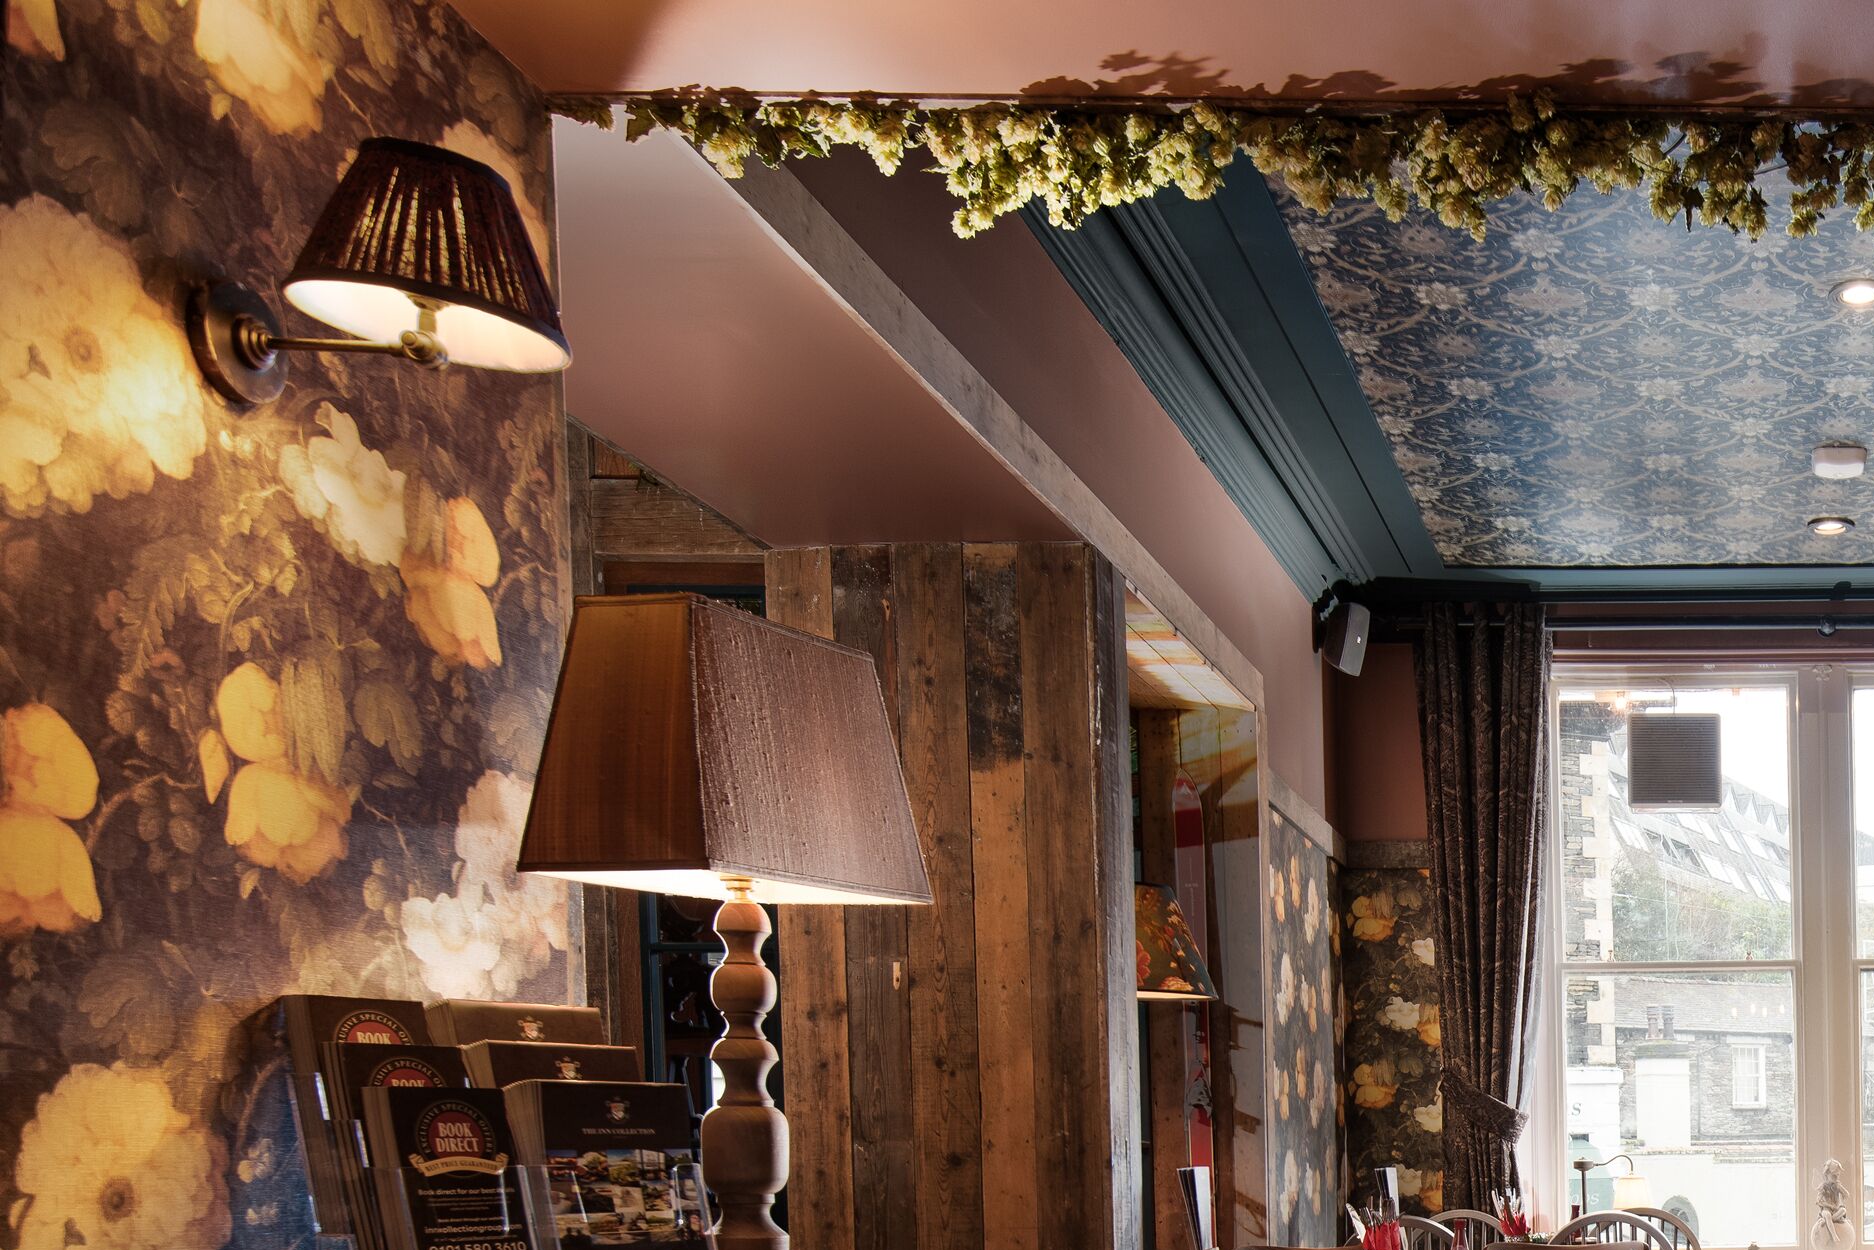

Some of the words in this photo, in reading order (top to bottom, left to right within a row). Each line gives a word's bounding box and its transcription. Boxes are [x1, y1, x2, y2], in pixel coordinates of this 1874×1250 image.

[360, 1013, 398, 1031] SPECIAL
[356, 1031, 392, 1045] BOOK
[437, 1122, 473, 1137] BOOK
[435, 1138, 479, 1153] DIRECT
[418, 1188, 434, 1196] Book
[456, 1187, 467, 1195] for
